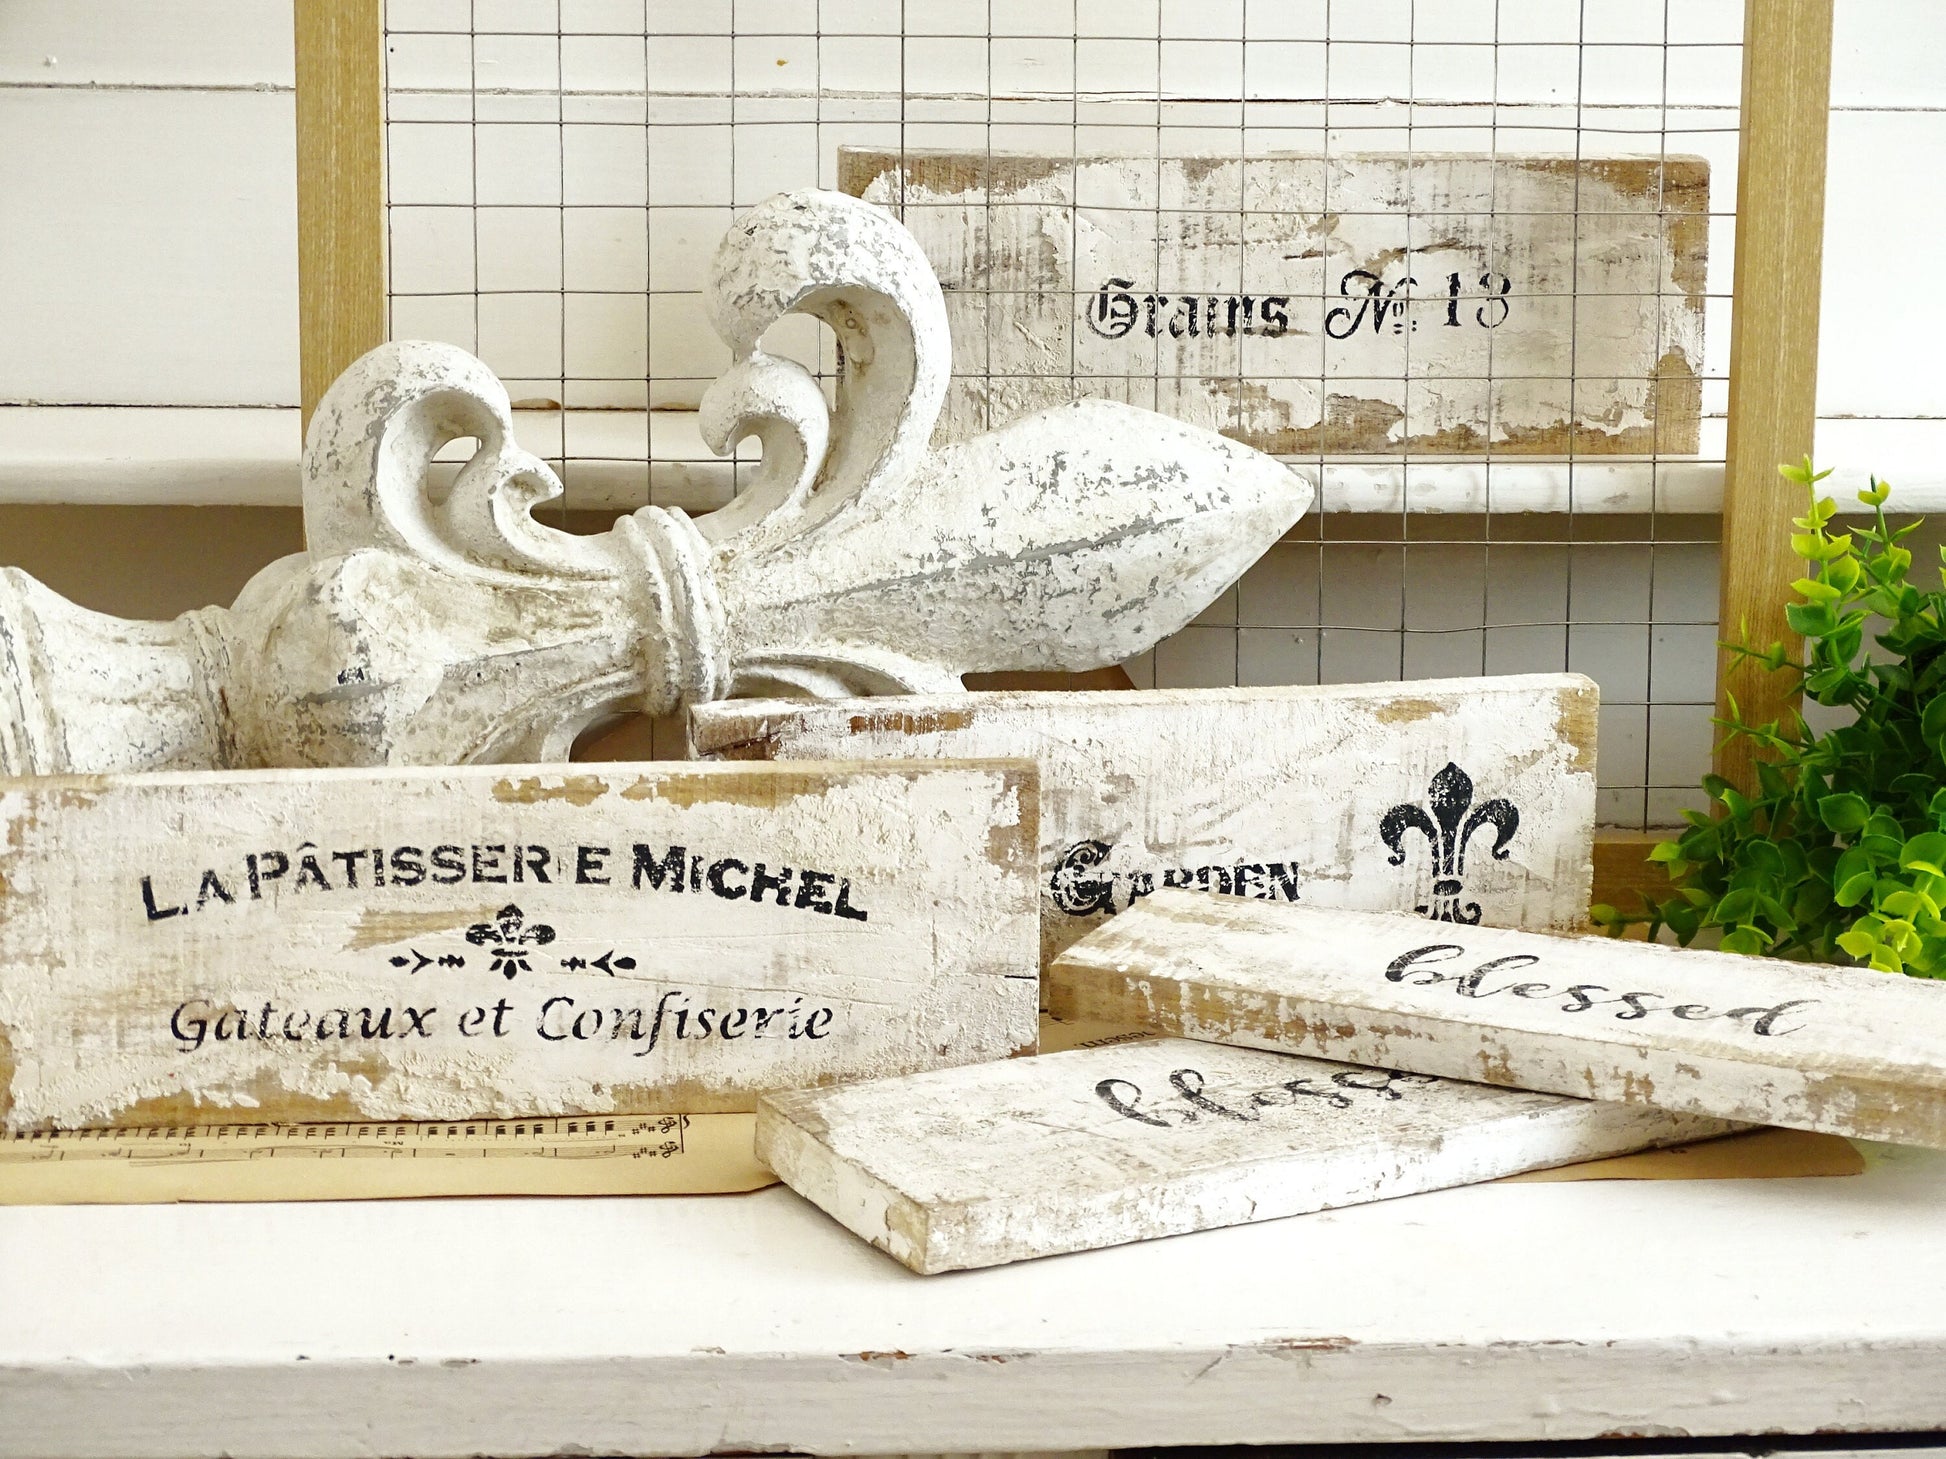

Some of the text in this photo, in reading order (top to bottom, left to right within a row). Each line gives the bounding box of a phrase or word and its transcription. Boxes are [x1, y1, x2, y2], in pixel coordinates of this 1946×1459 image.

[245, 842, 611, 900] PÂTISSERE
[632, 843, 868, 921] MICHEL
[170, 991, 833, 1057] Gateaux et Confiserie
